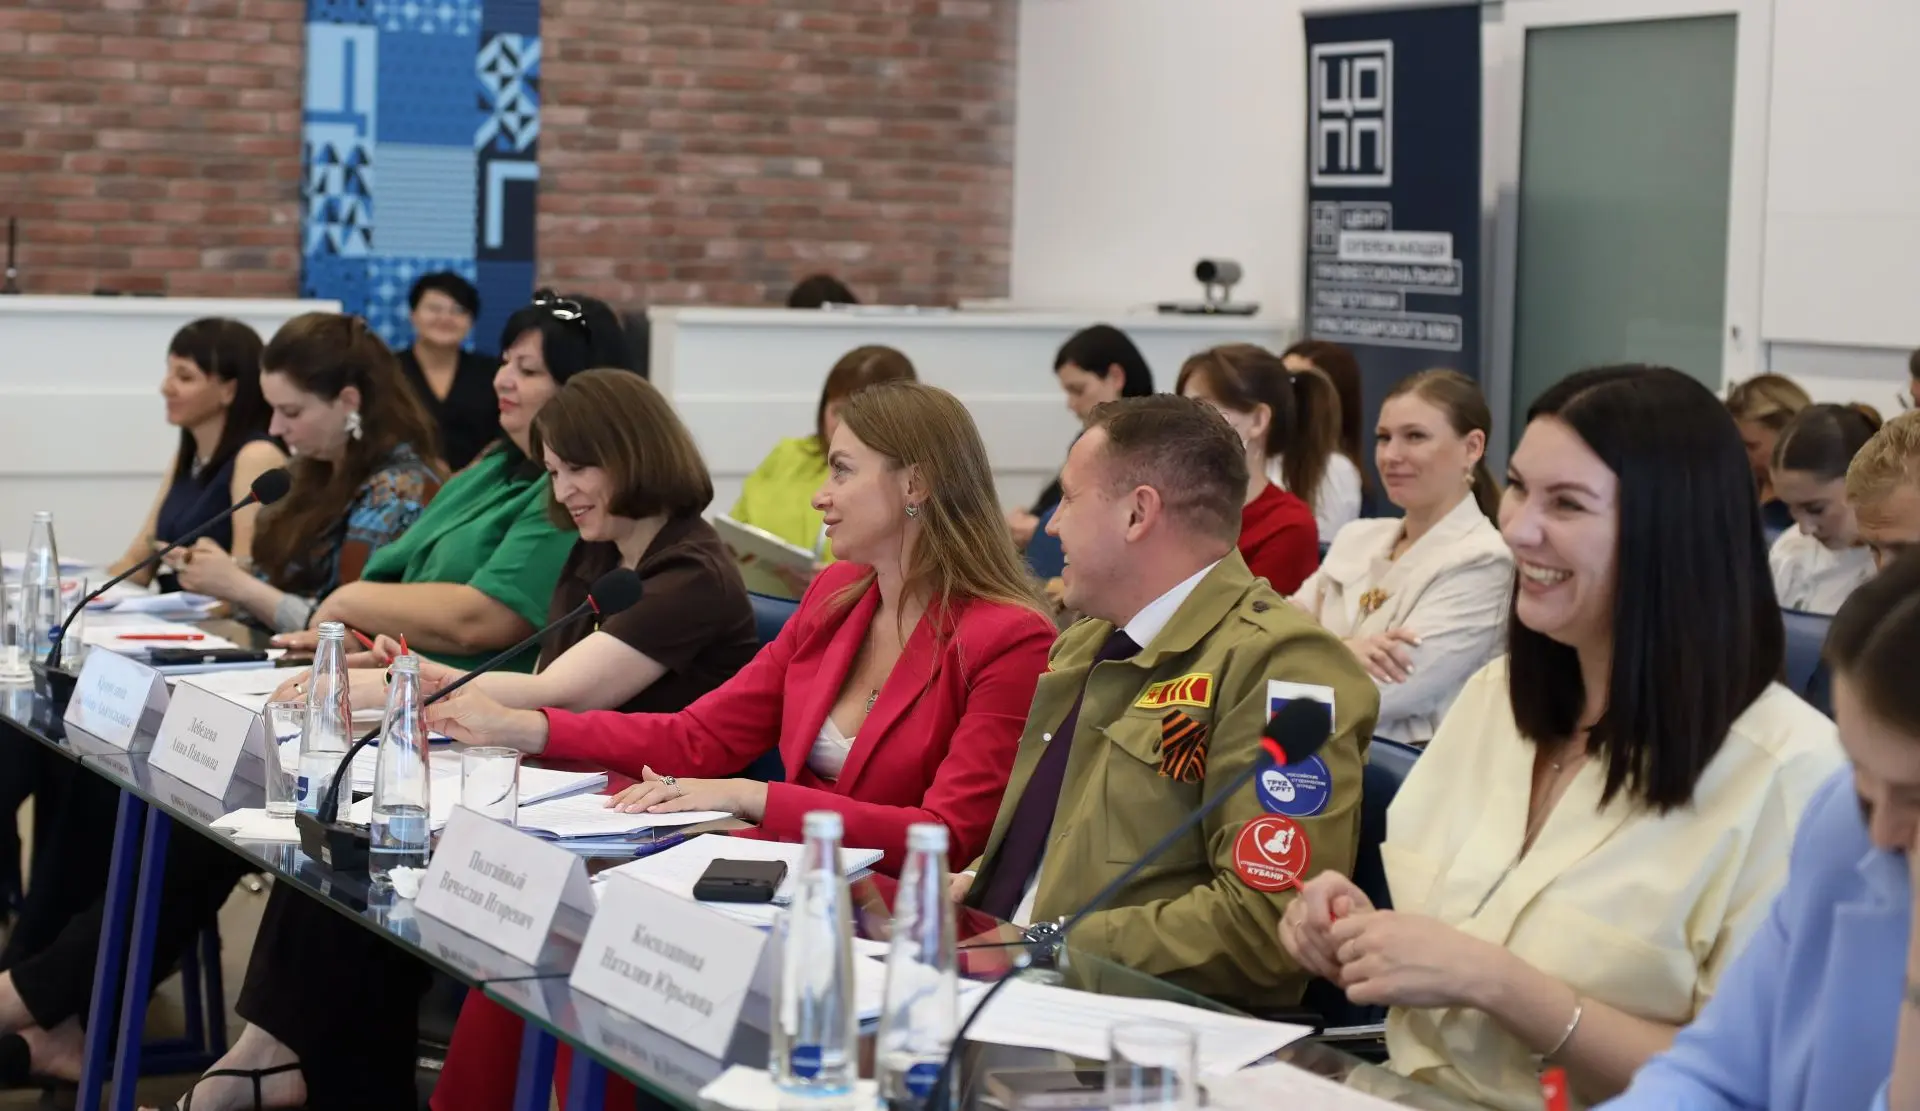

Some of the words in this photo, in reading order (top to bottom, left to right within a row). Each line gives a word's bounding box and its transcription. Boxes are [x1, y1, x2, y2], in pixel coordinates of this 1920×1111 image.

[1345, 210, 1387, 229] ЦЕНТР
[1266, 779, 1288, 787] ТРУД
[1247, 867, 1284, 881] КУБАНИ
[484, 891, 536, 931] Игоревич
